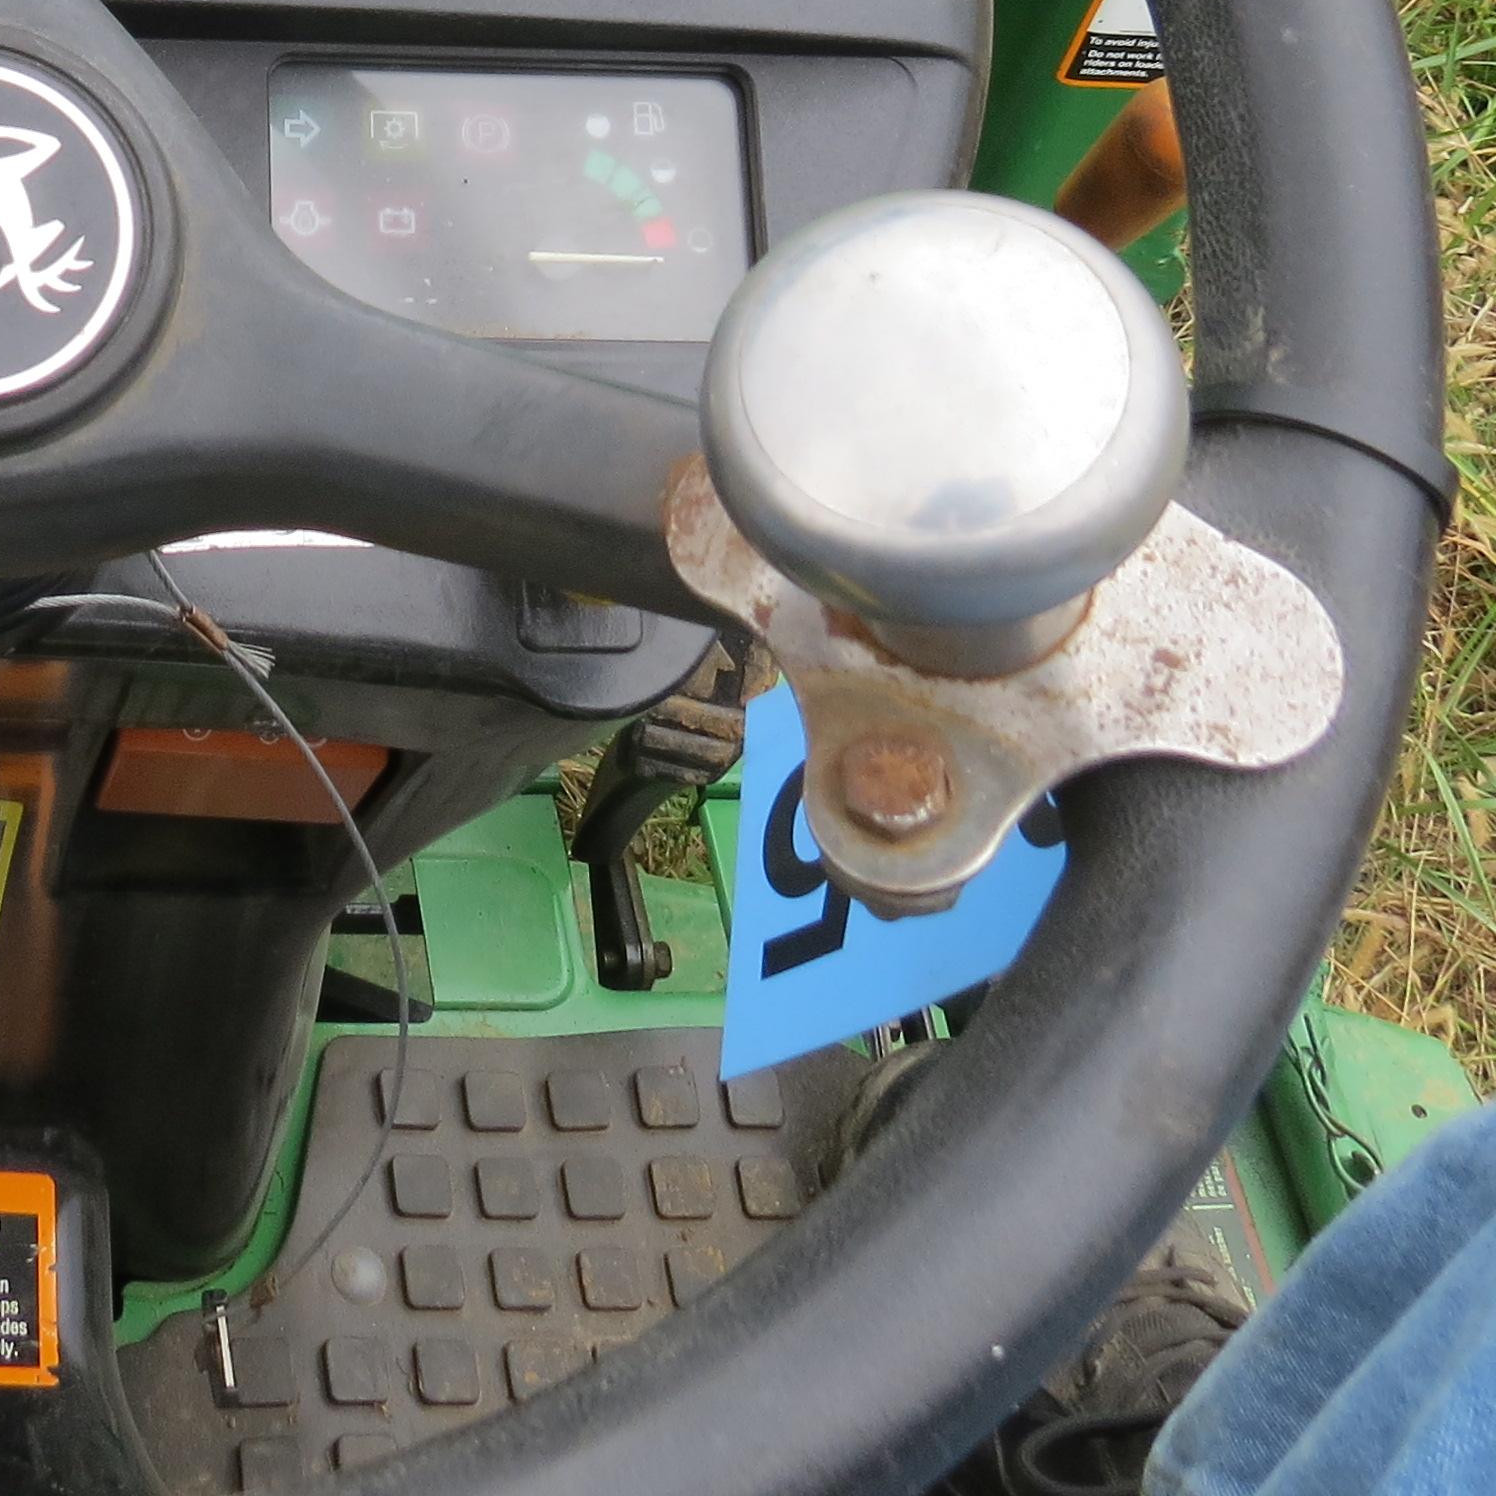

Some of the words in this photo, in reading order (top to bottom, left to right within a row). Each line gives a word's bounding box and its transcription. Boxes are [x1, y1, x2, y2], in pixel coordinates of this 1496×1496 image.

[1089, 36, 1103, 46] To
[1104, 38, 1136, 47] avoid
[1137, 39, 1161, 49] inju
[1088, 49, 1104, 58] Do
[1084, 59, 1116, 67] riders
[1134, 61, 1164, 69] loade
